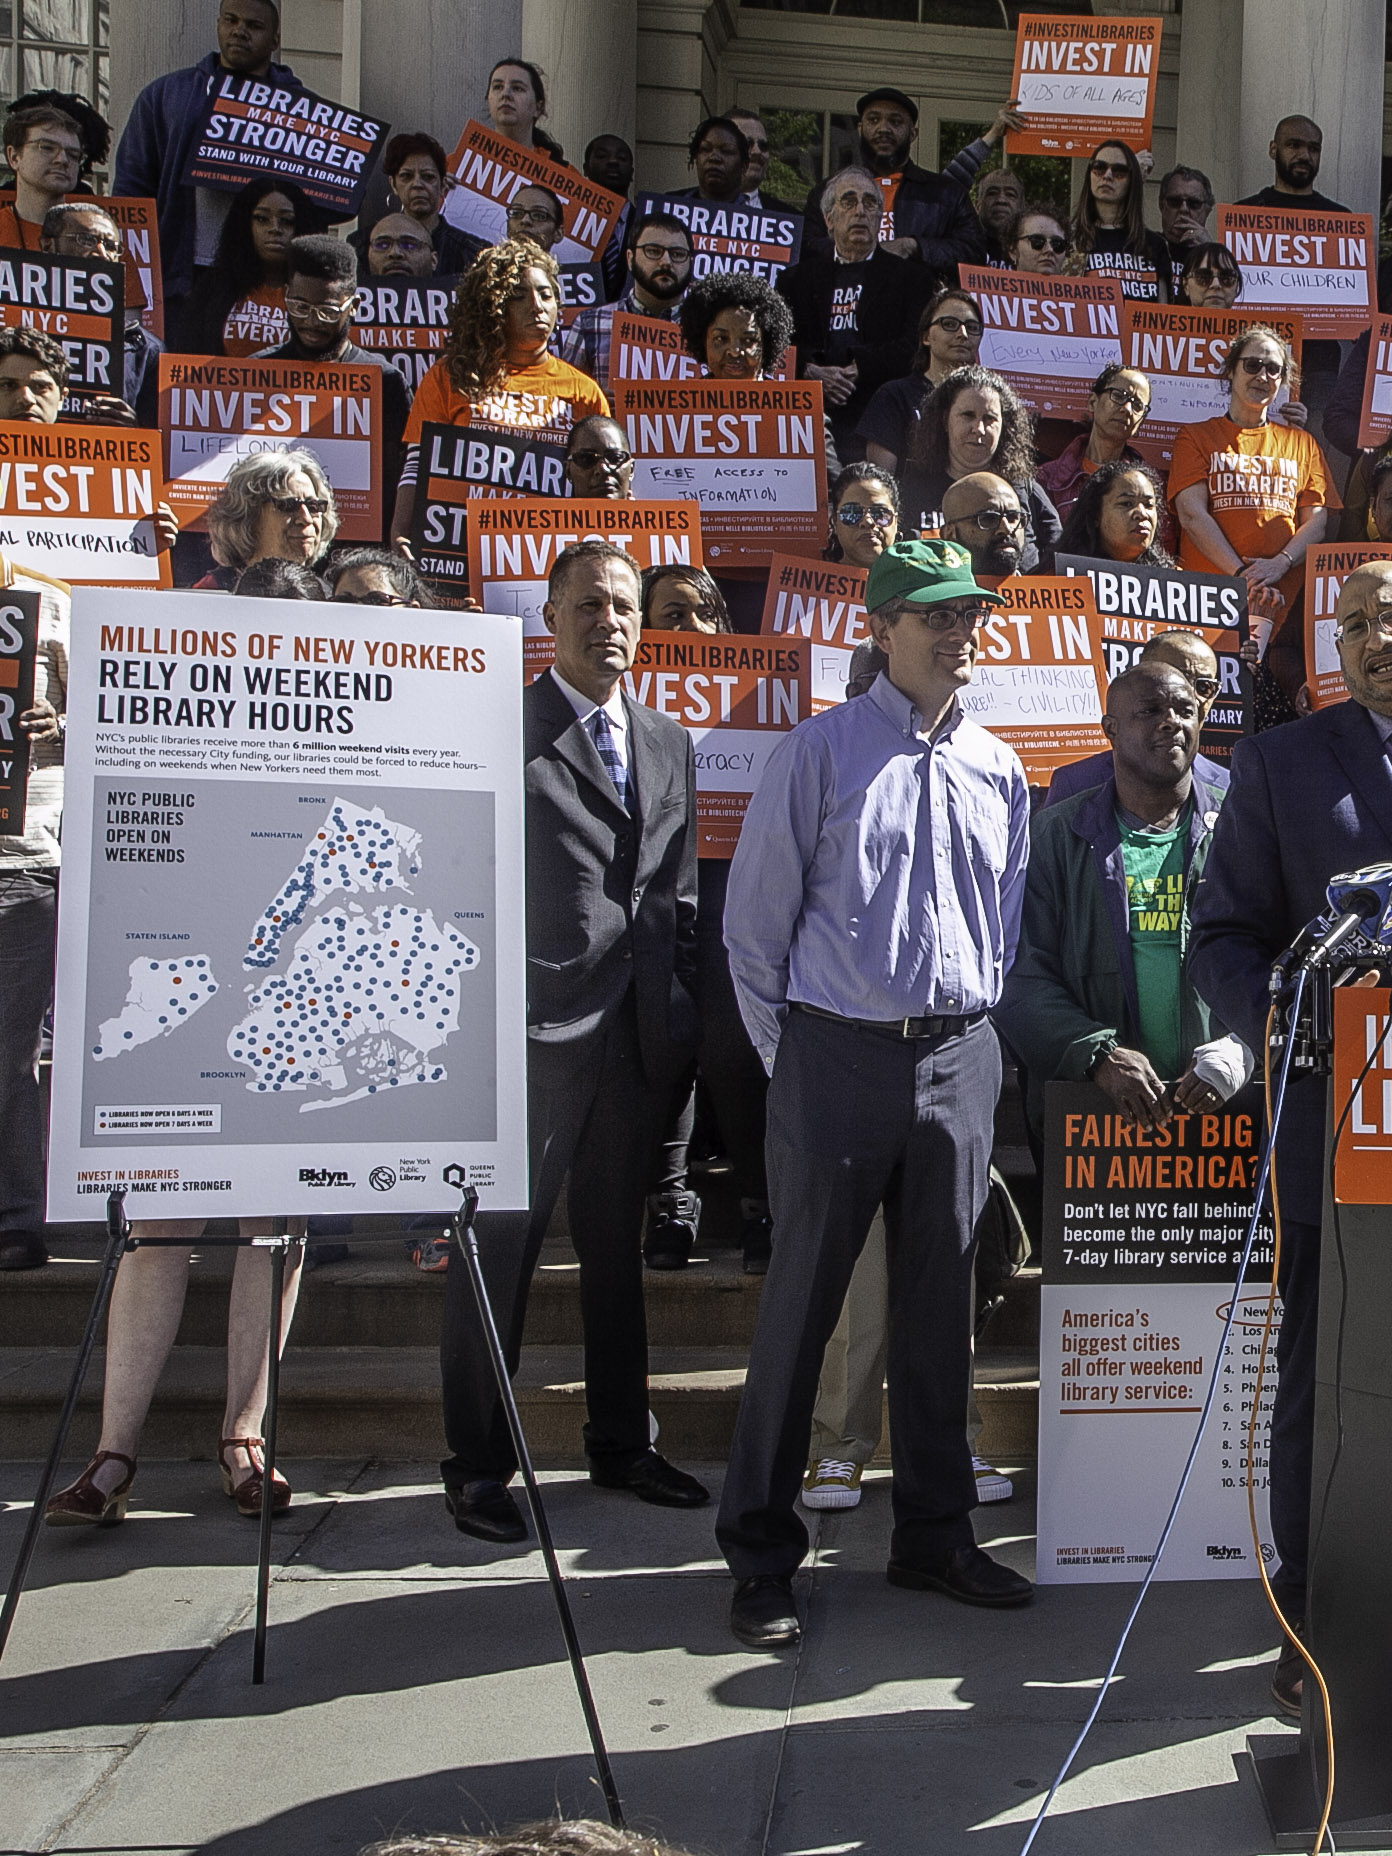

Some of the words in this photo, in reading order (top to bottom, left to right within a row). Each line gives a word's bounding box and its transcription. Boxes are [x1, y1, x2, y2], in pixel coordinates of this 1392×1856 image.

[1024, 22, 1155, 41] #INVESTINLIBRARIES
[1021, 41, 1116, 73] INVEST
[1124, 43, 1153, 73] IN
[1064, 85, 1080, 101] OF
[1083, 86, 1106, 102] ALL
[1111, 89, 1146, 106] AGES
[219, 75, 381, 142] LIBRARIES
[247, 107, 297, 129] MAKE
[304, 123, 340, 143] NYC
[205, 114, 366, 173] STRONGER
[198, 145, 236, 162] STAND
[240, 152, 269, 168] WITH
[273, 158, 305, 173] YOUR
[307, 165, 358, 190] LIBRARY
[1224, 211, 1366, 236] #INVESTINLIBRARIES
[1225, 230, 1334, 264] INVEST
[1339, 238, 1367, 267] IN
[1280, 272, 1357, 290] CHILDREN
[991, 334, 1045, 364] Every
[1050, 348, 1080, 363] New
[1082, 342, 1119, 366] Yorker
[624, 390, 813, 410] #INVESTINLIBRARIES
[626, 414, 763, 454] INVEST
[777, 414, 815, 455] IN
[650, 466, 697, 481] FREE
[714, 467, 764, 478] ACCESS
[774, 468, 788, 477] TO
[1208, 453, 1274, 474] INVEST
[1280, 456, 1298, 476] IN
[678, 487, 777, 502] INFORMATION
[1208, 471, 1298, 500] LIBRARIES
[101, 625, 237, 658] MILLIONS
[248, 633, 283, 661] OF
[294, 636, 355, 665] NEW
[364, 641, 487, 674] YORKERS
[100, 659, 178, 691] RELY
[189, 663, 232, 694] ON
[243, 666, 393, 702] WEEKEND
[97, 694, 236, 730] LIBRARY
[248, 701, 355, 734] HOURS
[96, 733, 125, 742] NYC's
[128, 735, 159, 744] public
[161, 735, 200, 746] libraries
[203, 738, 238, 747] receive
[241, 740, 266, 748] more
[268, 740, 290, 749] than
[292, 741, 300, 749] 6
[302, 742, 336, 751] million
[339, 744, 382, 754] weekend
[385, 745, 410, 755] visits
[412, 748, 437, 758] every
[440, 750, 461, 758] year.
[107, 791, 137, 807] NYC
[140, 792, 195, 808] PUBLIC
[298, 796, 326, 804] BRONX
[106, 810, 184, 826] LIBRARIES
[106, 828, 147, 844] OPEN
[151, 830, 172, 845] ON
[250, 831, 303, 839] MANHATTAN
[105, 848, 185, 863] WEEKENDS
[453, 911, 485, 919] QUEENS
[1139, 912, 1180, 931] WAY
[125, 932, 155, 940] STATEN
[200, 1071, 246, 1079] BROOKLYN
[78, 1171, 112, 1181] INVEST
[115, 1170, 125, 1180] IN
[128, 1169, 180, 1180] LIBRARIES
[1062, 1309, 1149, 1328] America's
[1062, 1333, 1127, 1356] biggest
[1133, 1332, 1180, 1351] cities
[1061, 1357, 1081, 1377] all
[1086, 1357, 1126, 1376] offer
[1130, 1356, 1203, 1375] weekend
[1061, 1382, 1118, 1404] library
[1124, 1381, 1193, 1400] service:
